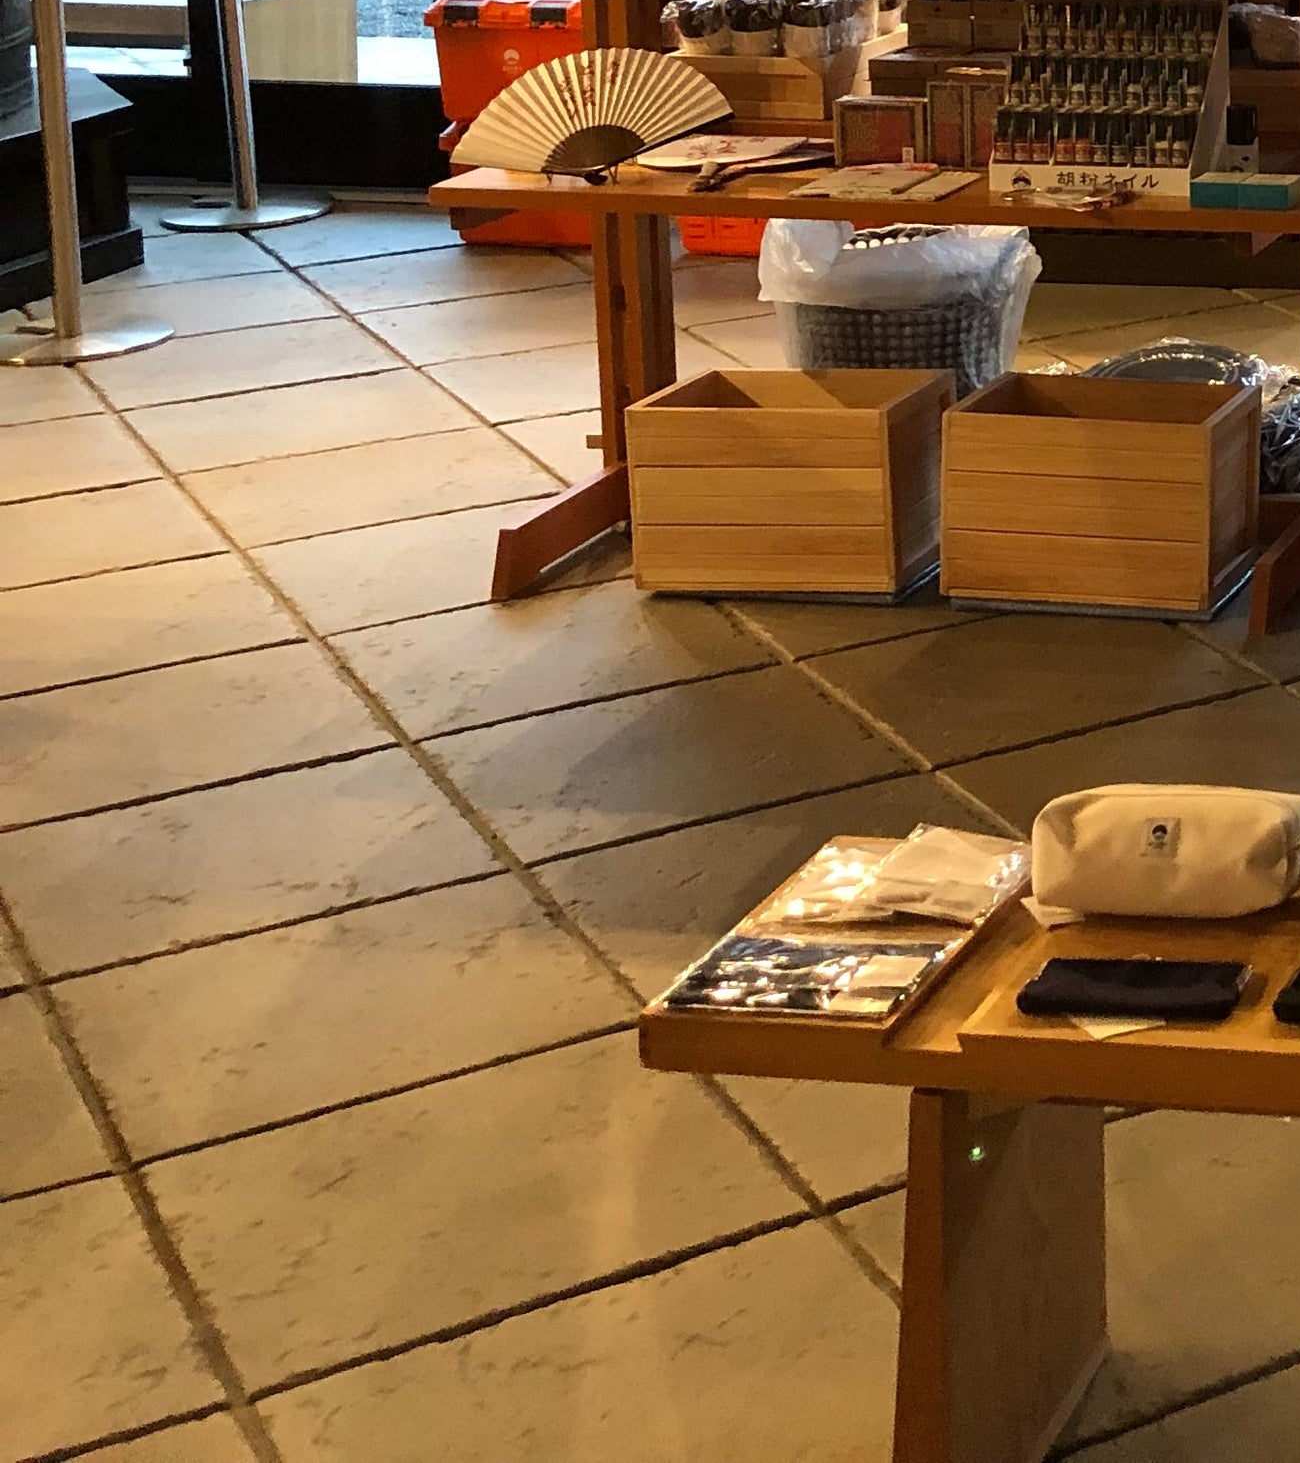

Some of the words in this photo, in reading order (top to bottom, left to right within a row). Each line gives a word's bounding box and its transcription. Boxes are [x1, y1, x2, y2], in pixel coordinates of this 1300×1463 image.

[1056, 171, 1160, 189] 胡粉ネイル
